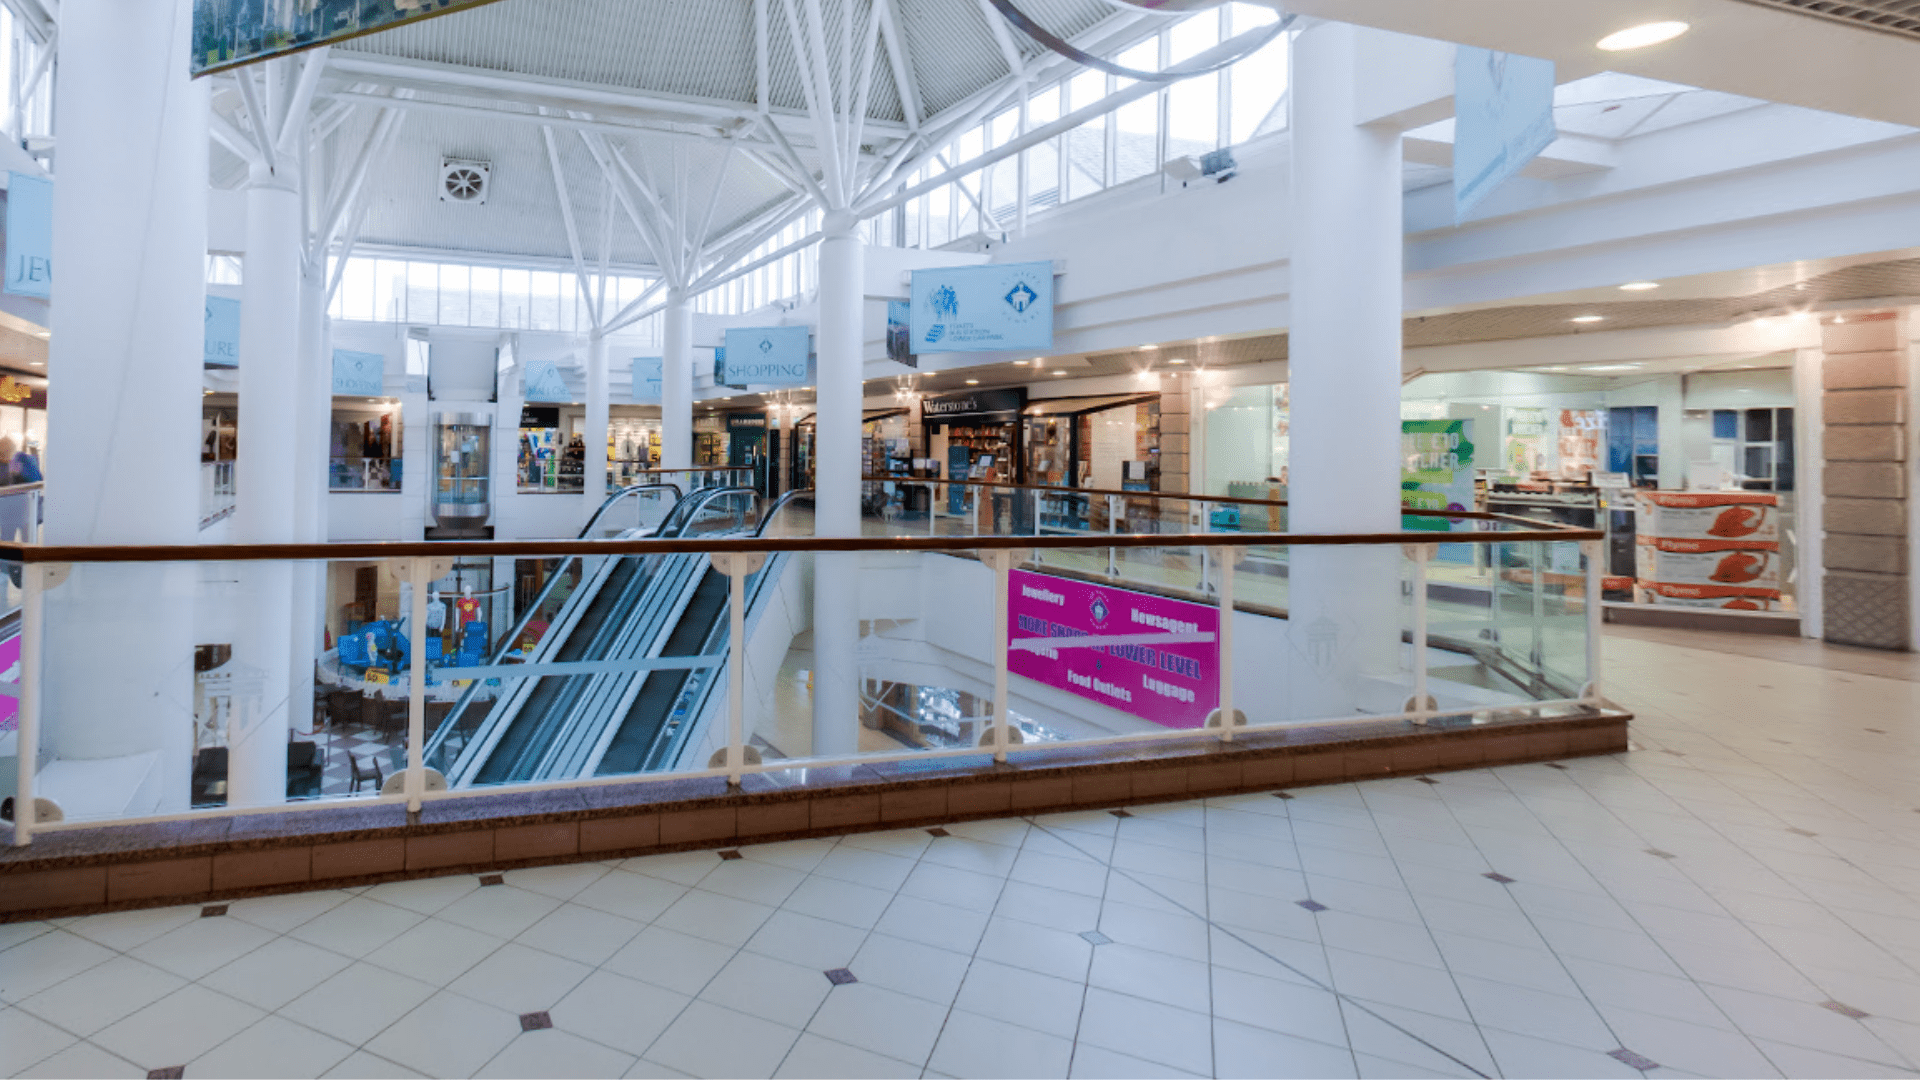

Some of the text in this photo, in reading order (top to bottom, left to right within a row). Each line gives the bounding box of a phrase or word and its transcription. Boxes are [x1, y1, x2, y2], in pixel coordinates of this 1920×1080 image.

[728, 363, 804, 377] SHOPPING
[1022, 584, 1065, 606] Jewellery
[1131, 608, 1198, 634] Newsagent
[1018, 614, 1048, 637] MORE
[1109, 644, 1156, 667] LOWER
[1159, 650, 1201, 680] LEVEL
[1067, 669, 1132, 703] Food Outlets
[1142, 673, 1195, 703] Luggage
